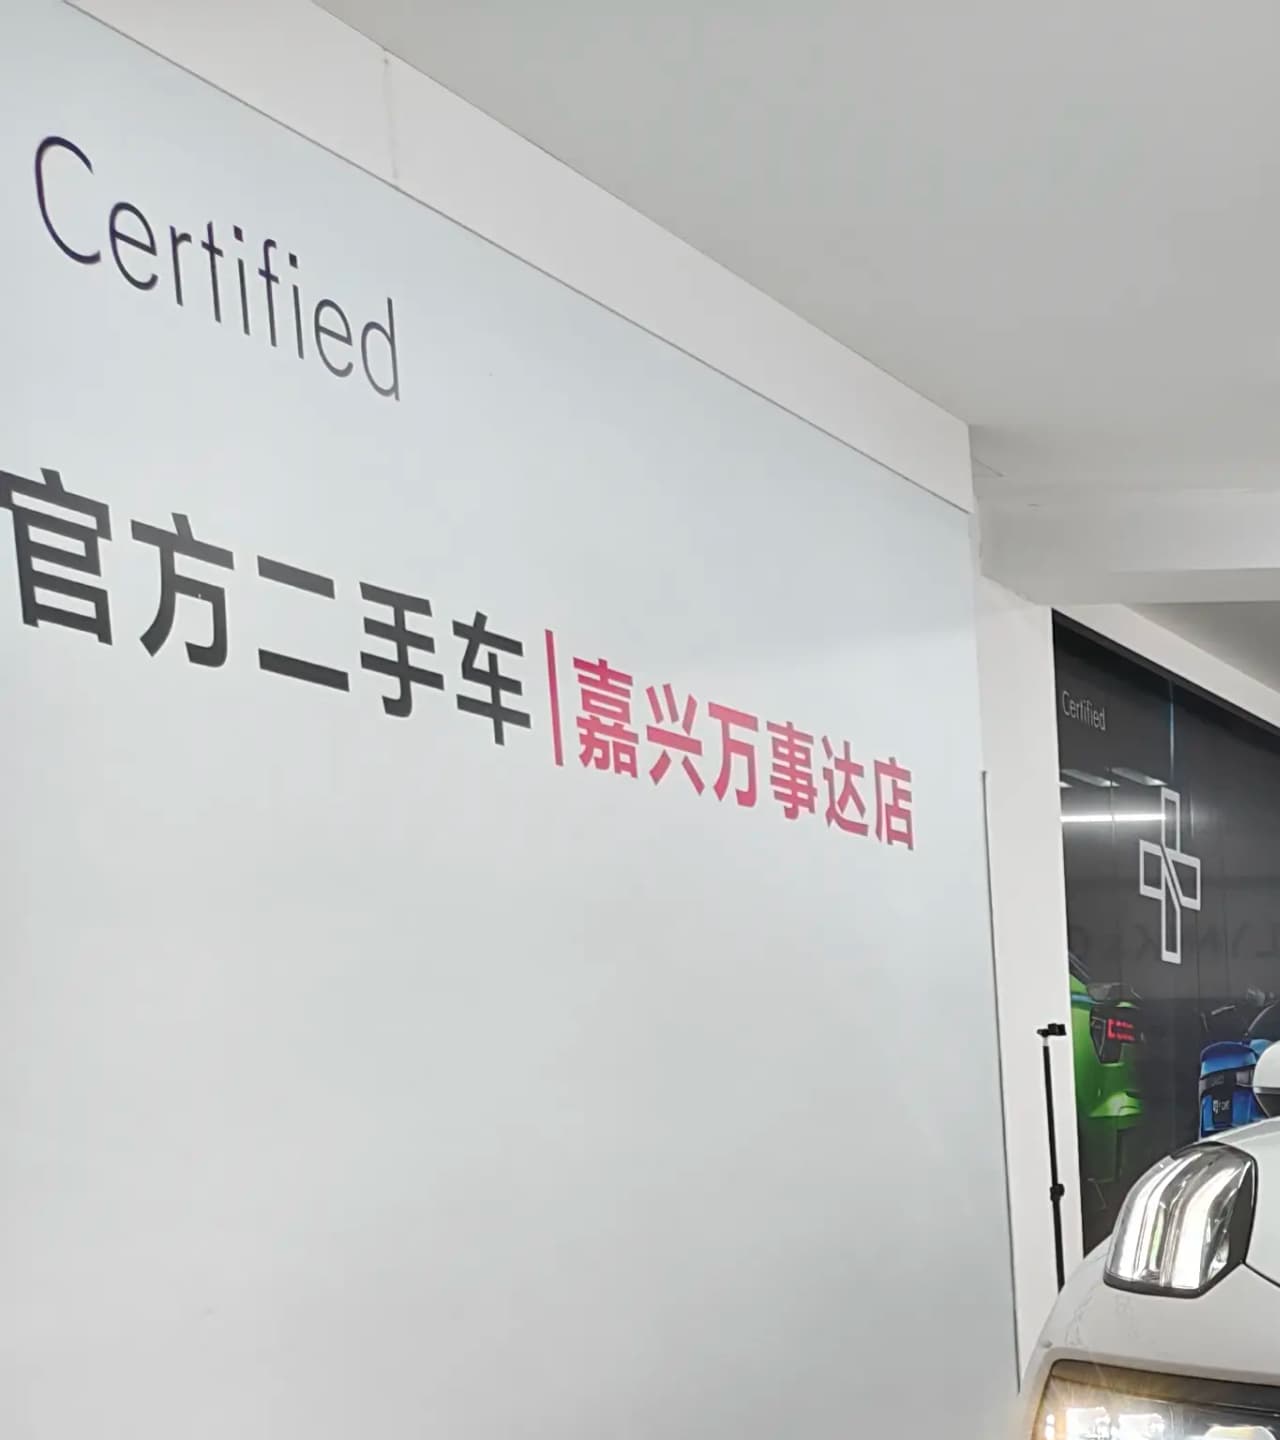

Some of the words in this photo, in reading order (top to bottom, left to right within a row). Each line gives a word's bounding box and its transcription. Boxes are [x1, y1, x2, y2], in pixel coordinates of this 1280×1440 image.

[34, 136, 401, 401] Certified
[0, 467, 532, 746] 官方二手车
[573, 657, 915, 850] 嘉兴万事达店
[1061, 690, 1106, 731] Certified
